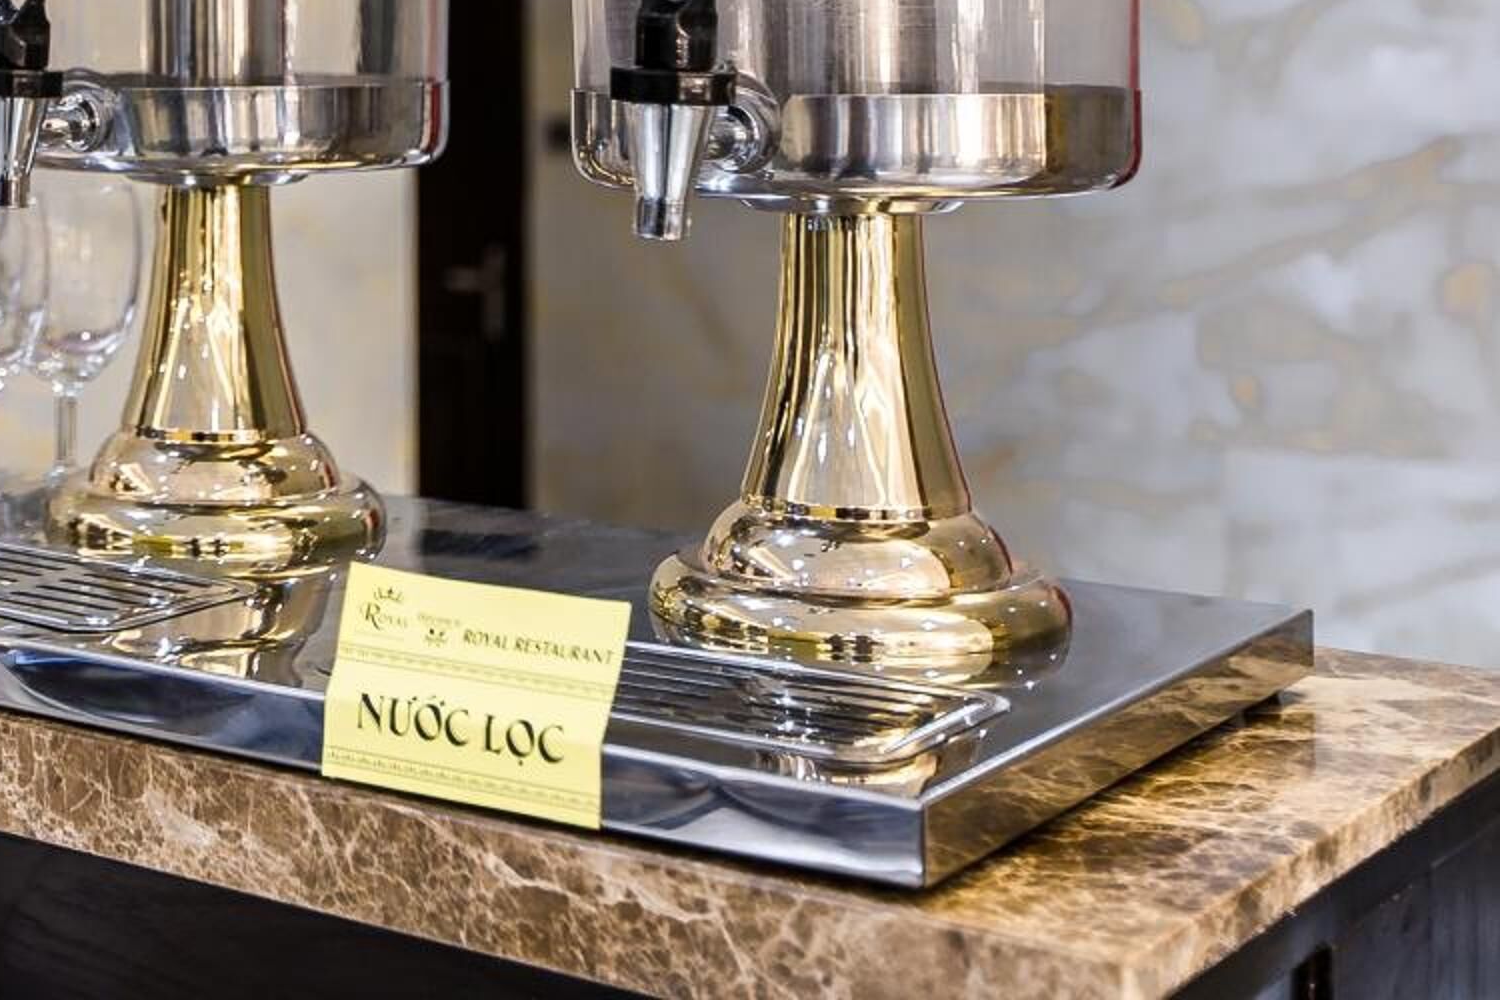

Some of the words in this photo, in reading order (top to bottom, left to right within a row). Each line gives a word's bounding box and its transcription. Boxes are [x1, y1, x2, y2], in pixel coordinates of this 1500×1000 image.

[462, 628, 508, 651] ROYAL
[513, 636, 615, 665] RESTAURANT
[356, 692, 470, 748] NƯỚC
[483, 713, 565, 767] LỌC
